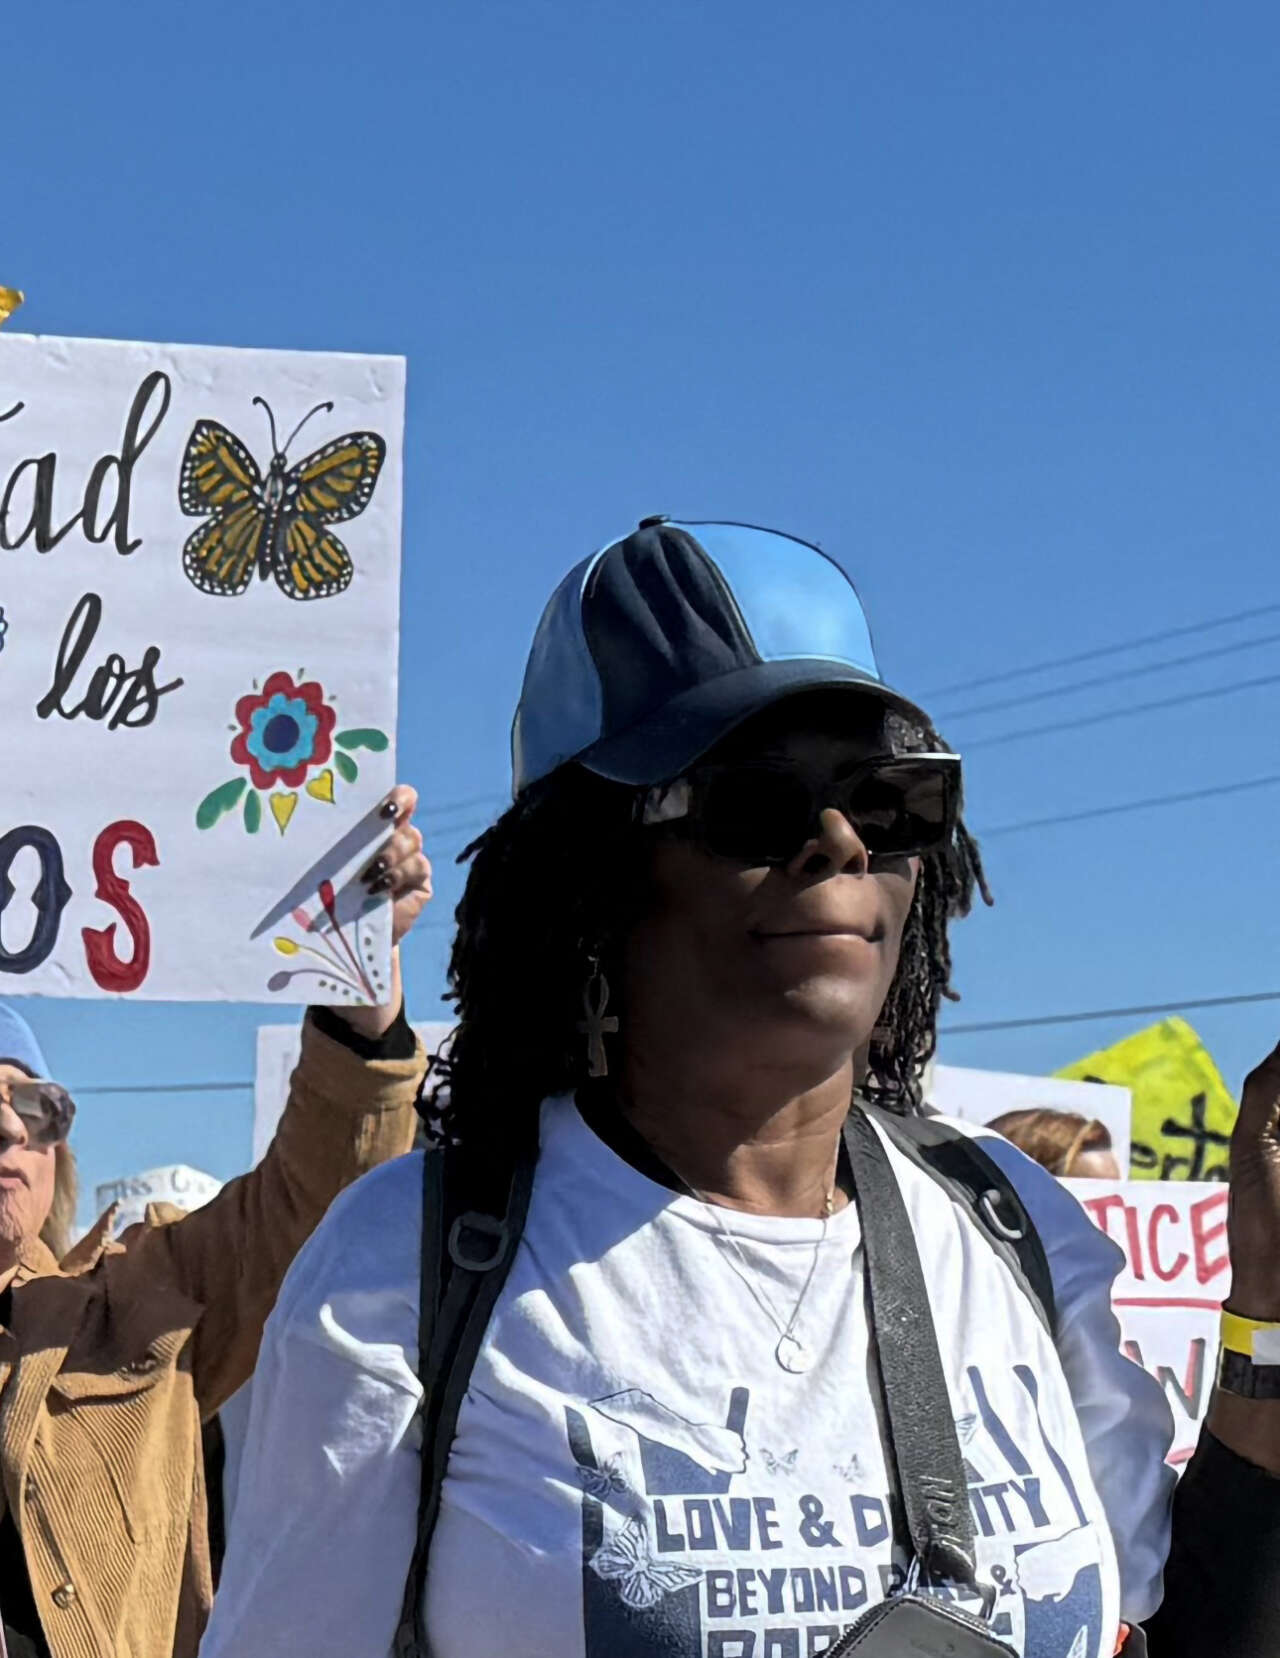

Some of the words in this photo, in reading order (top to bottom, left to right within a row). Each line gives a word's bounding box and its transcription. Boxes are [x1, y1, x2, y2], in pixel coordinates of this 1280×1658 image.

[36, 593, 184, 730] los
[655, 1496, 783, 1552] LOVE
[798, 1494, 843, 1548] &
[850, 1478, 1051, 1547] DITY
[705, 1564, 869, 1619] BEYOND
